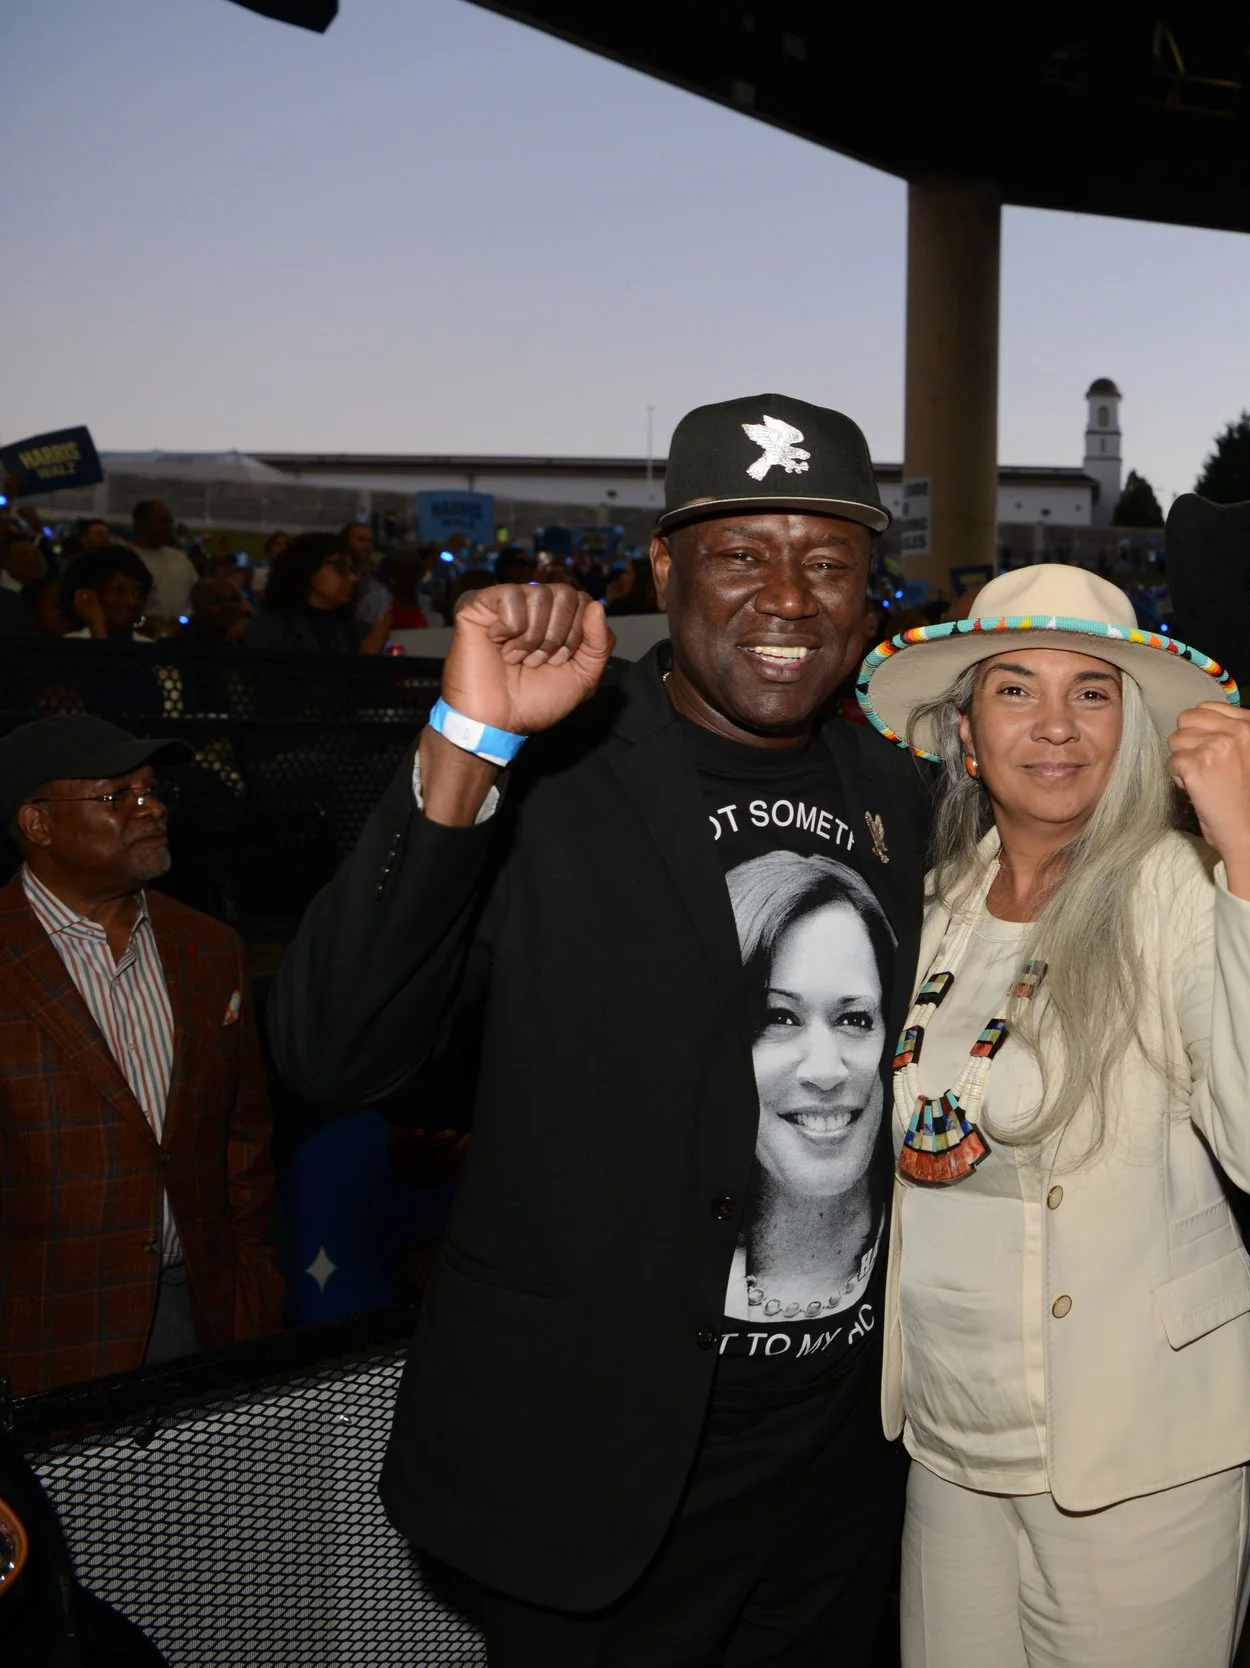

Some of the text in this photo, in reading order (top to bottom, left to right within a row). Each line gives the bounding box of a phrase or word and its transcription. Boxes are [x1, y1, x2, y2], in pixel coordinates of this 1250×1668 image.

[19, 441, 81, 470] HARRIS
[37, 461, 77, 479] WALZ
[747, 1332, 792, 1357] TO
[796, 1327, 843, 1358] MY
